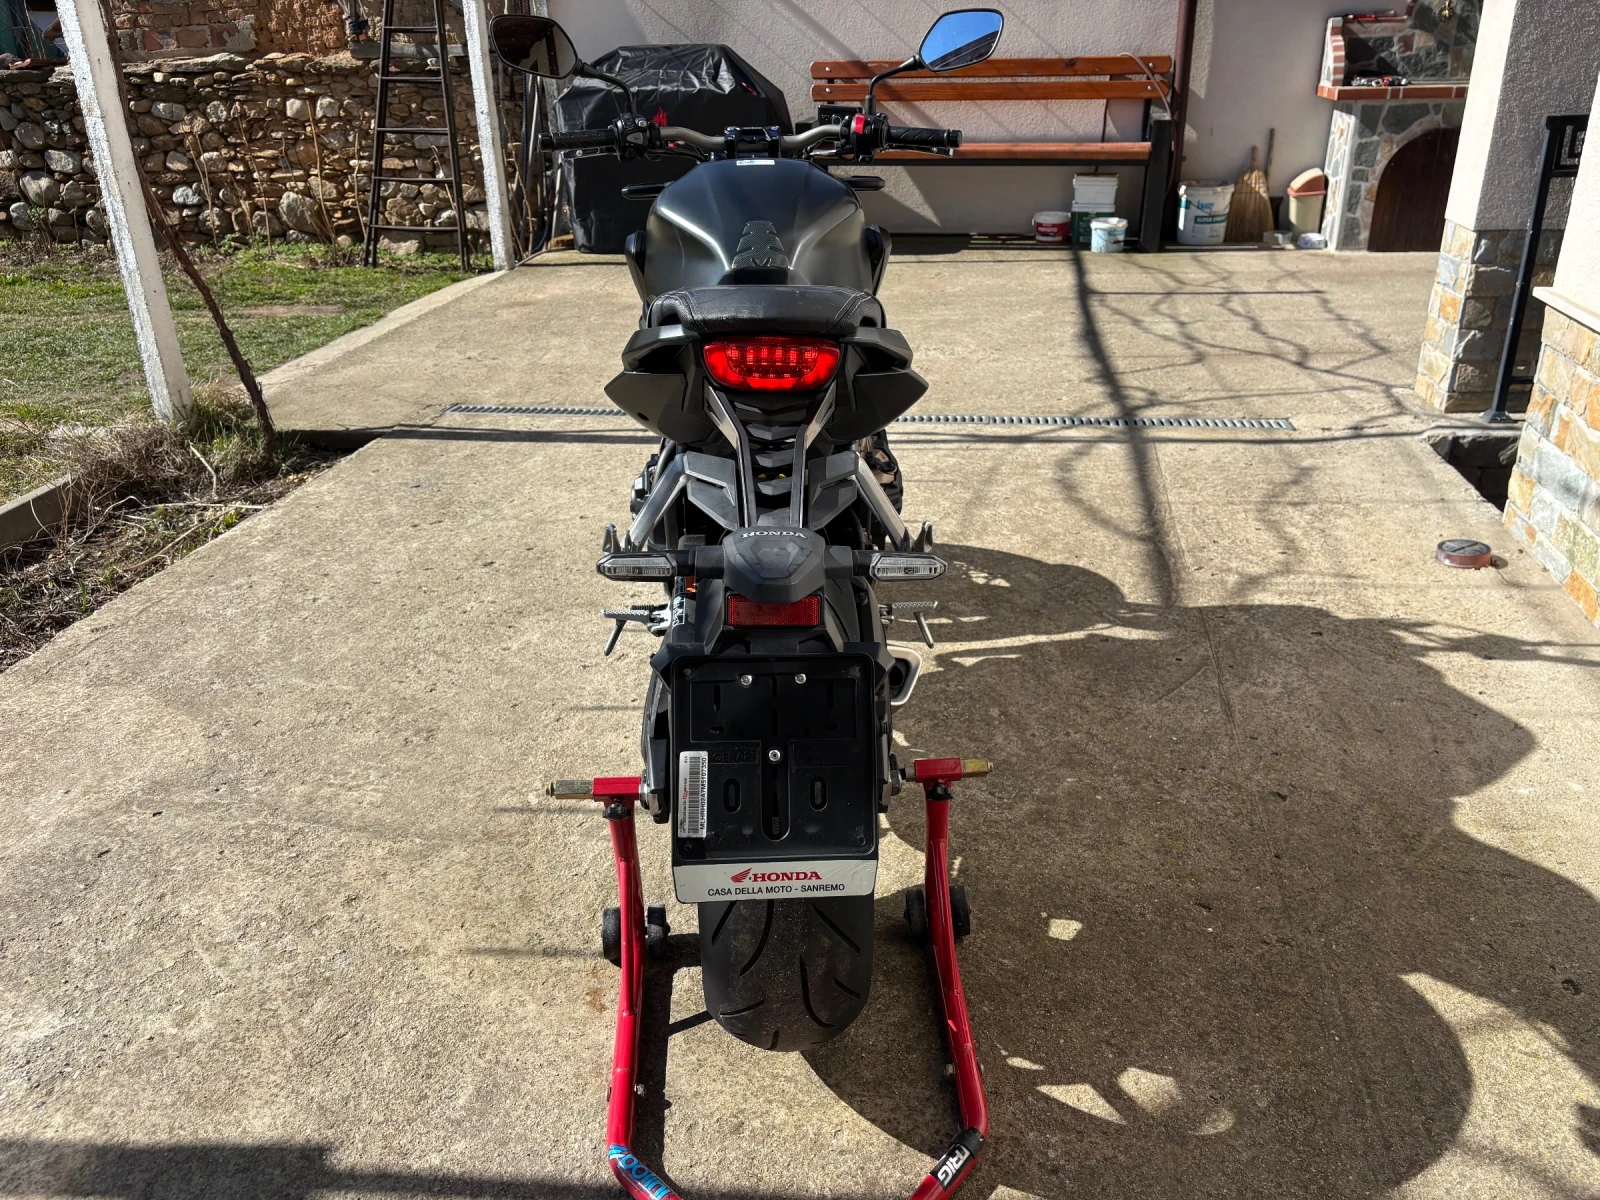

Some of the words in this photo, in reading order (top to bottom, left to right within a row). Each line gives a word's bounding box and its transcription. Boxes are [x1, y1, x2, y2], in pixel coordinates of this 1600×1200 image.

[741, 531, 808, 539] HONDA
[752, 871, 822, 883] HONDA
[708, 888, 733, 896] CASA
[735, 886, 764, 895] DELLA
[765, 885, 792, 894] MOTO
[800, 883, 845, 892] SANREMO
